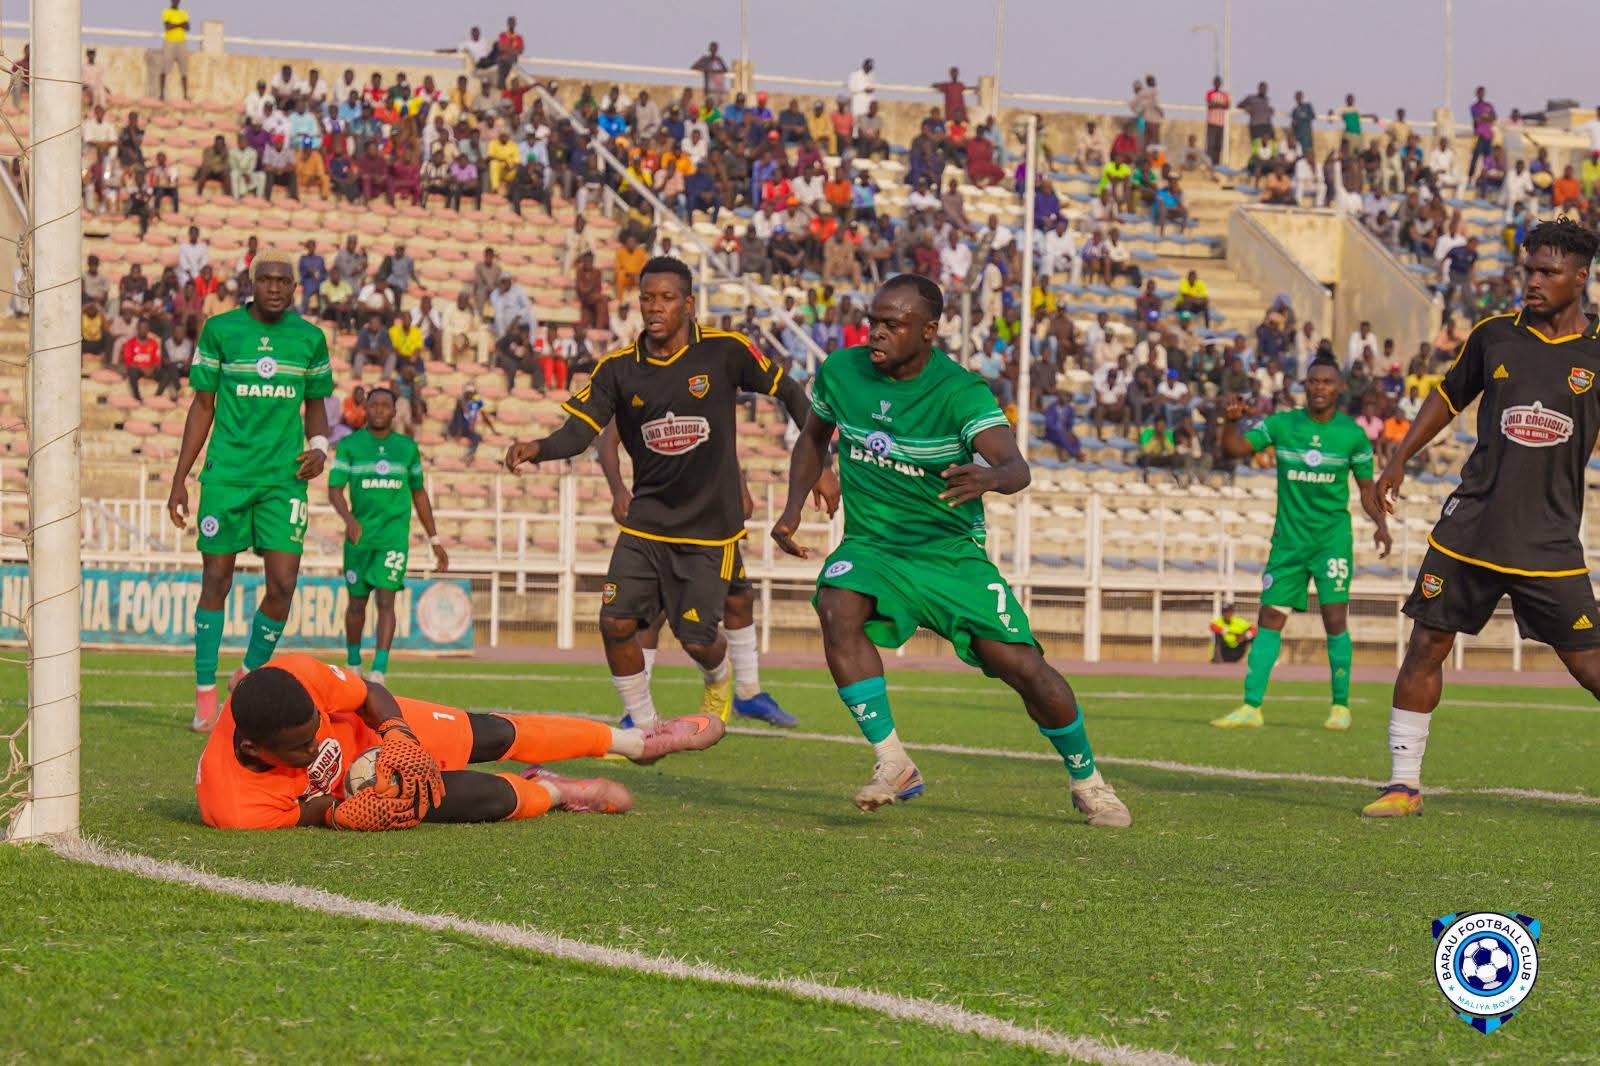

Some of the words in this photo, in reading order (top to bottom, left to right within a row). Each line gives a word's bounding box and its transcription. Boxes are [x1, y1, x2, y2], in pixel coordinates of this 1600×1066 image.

[236, 384, 296, 398] BARAU
[361, 478, 403, 490] BARAU
[1287, 469, 1335, 483] BARAU
[289, 498, 307, 526] 19
[384, 550, 406, 570] 22
[1327, 558, 1348, 579] 35
[2, 575, 111, 632] NIIA
[118, 579, 249, 637] FOOTBLL
[987, 583, 1006, 613] 7
[308, 749, 335, 780] GLISH
